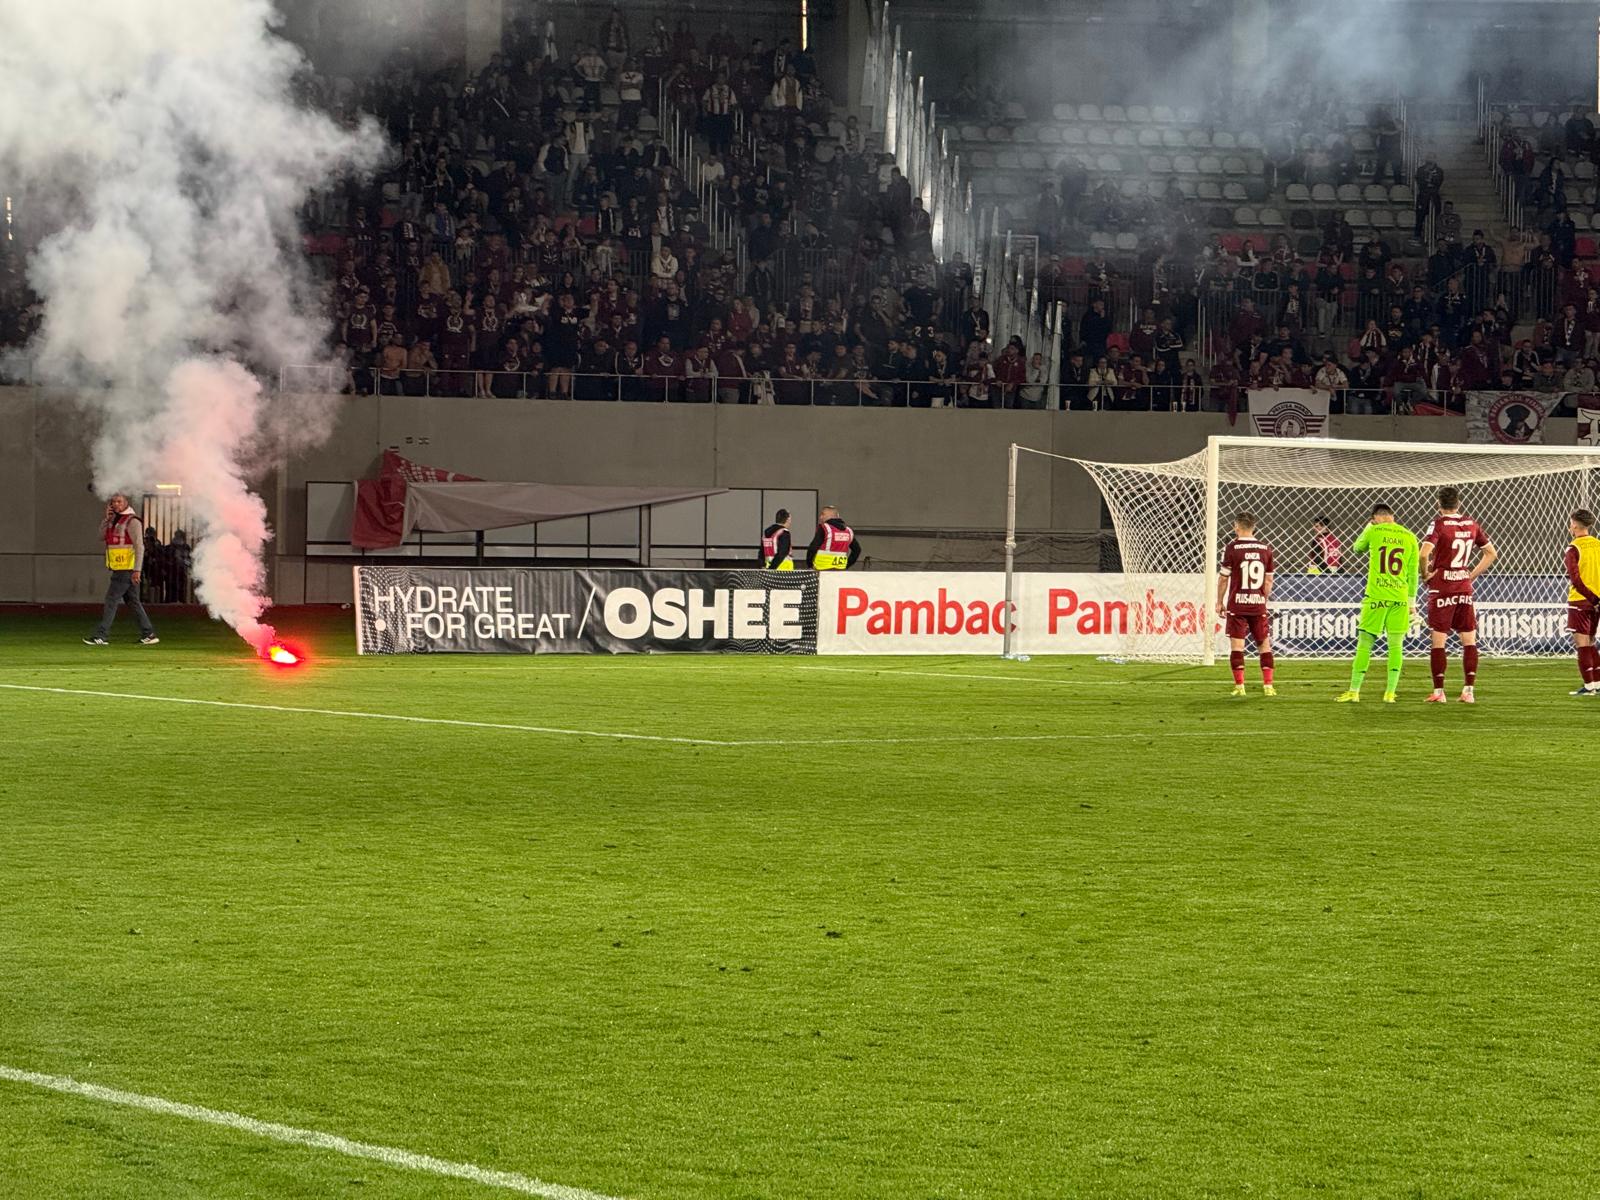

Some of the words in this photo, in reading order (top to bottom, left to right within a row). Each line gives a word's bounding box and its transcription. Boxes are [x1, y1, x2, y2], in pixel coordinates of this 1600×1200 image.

[1378, 545, 1405, 576] 16
[1450, 539, 1473, 568] 21
[1240, 560, 1265, 590] 19
[374, 586, 514, 613] HYDRATE
[603, 586, 803, 640] OSHEE
[836, 587, 1017, 636] Pambac
[1437, 595, 1473, 608] DACRIS
[406, 613, 466, 640] FOR
[474, 613, 571, 640] GREAT
